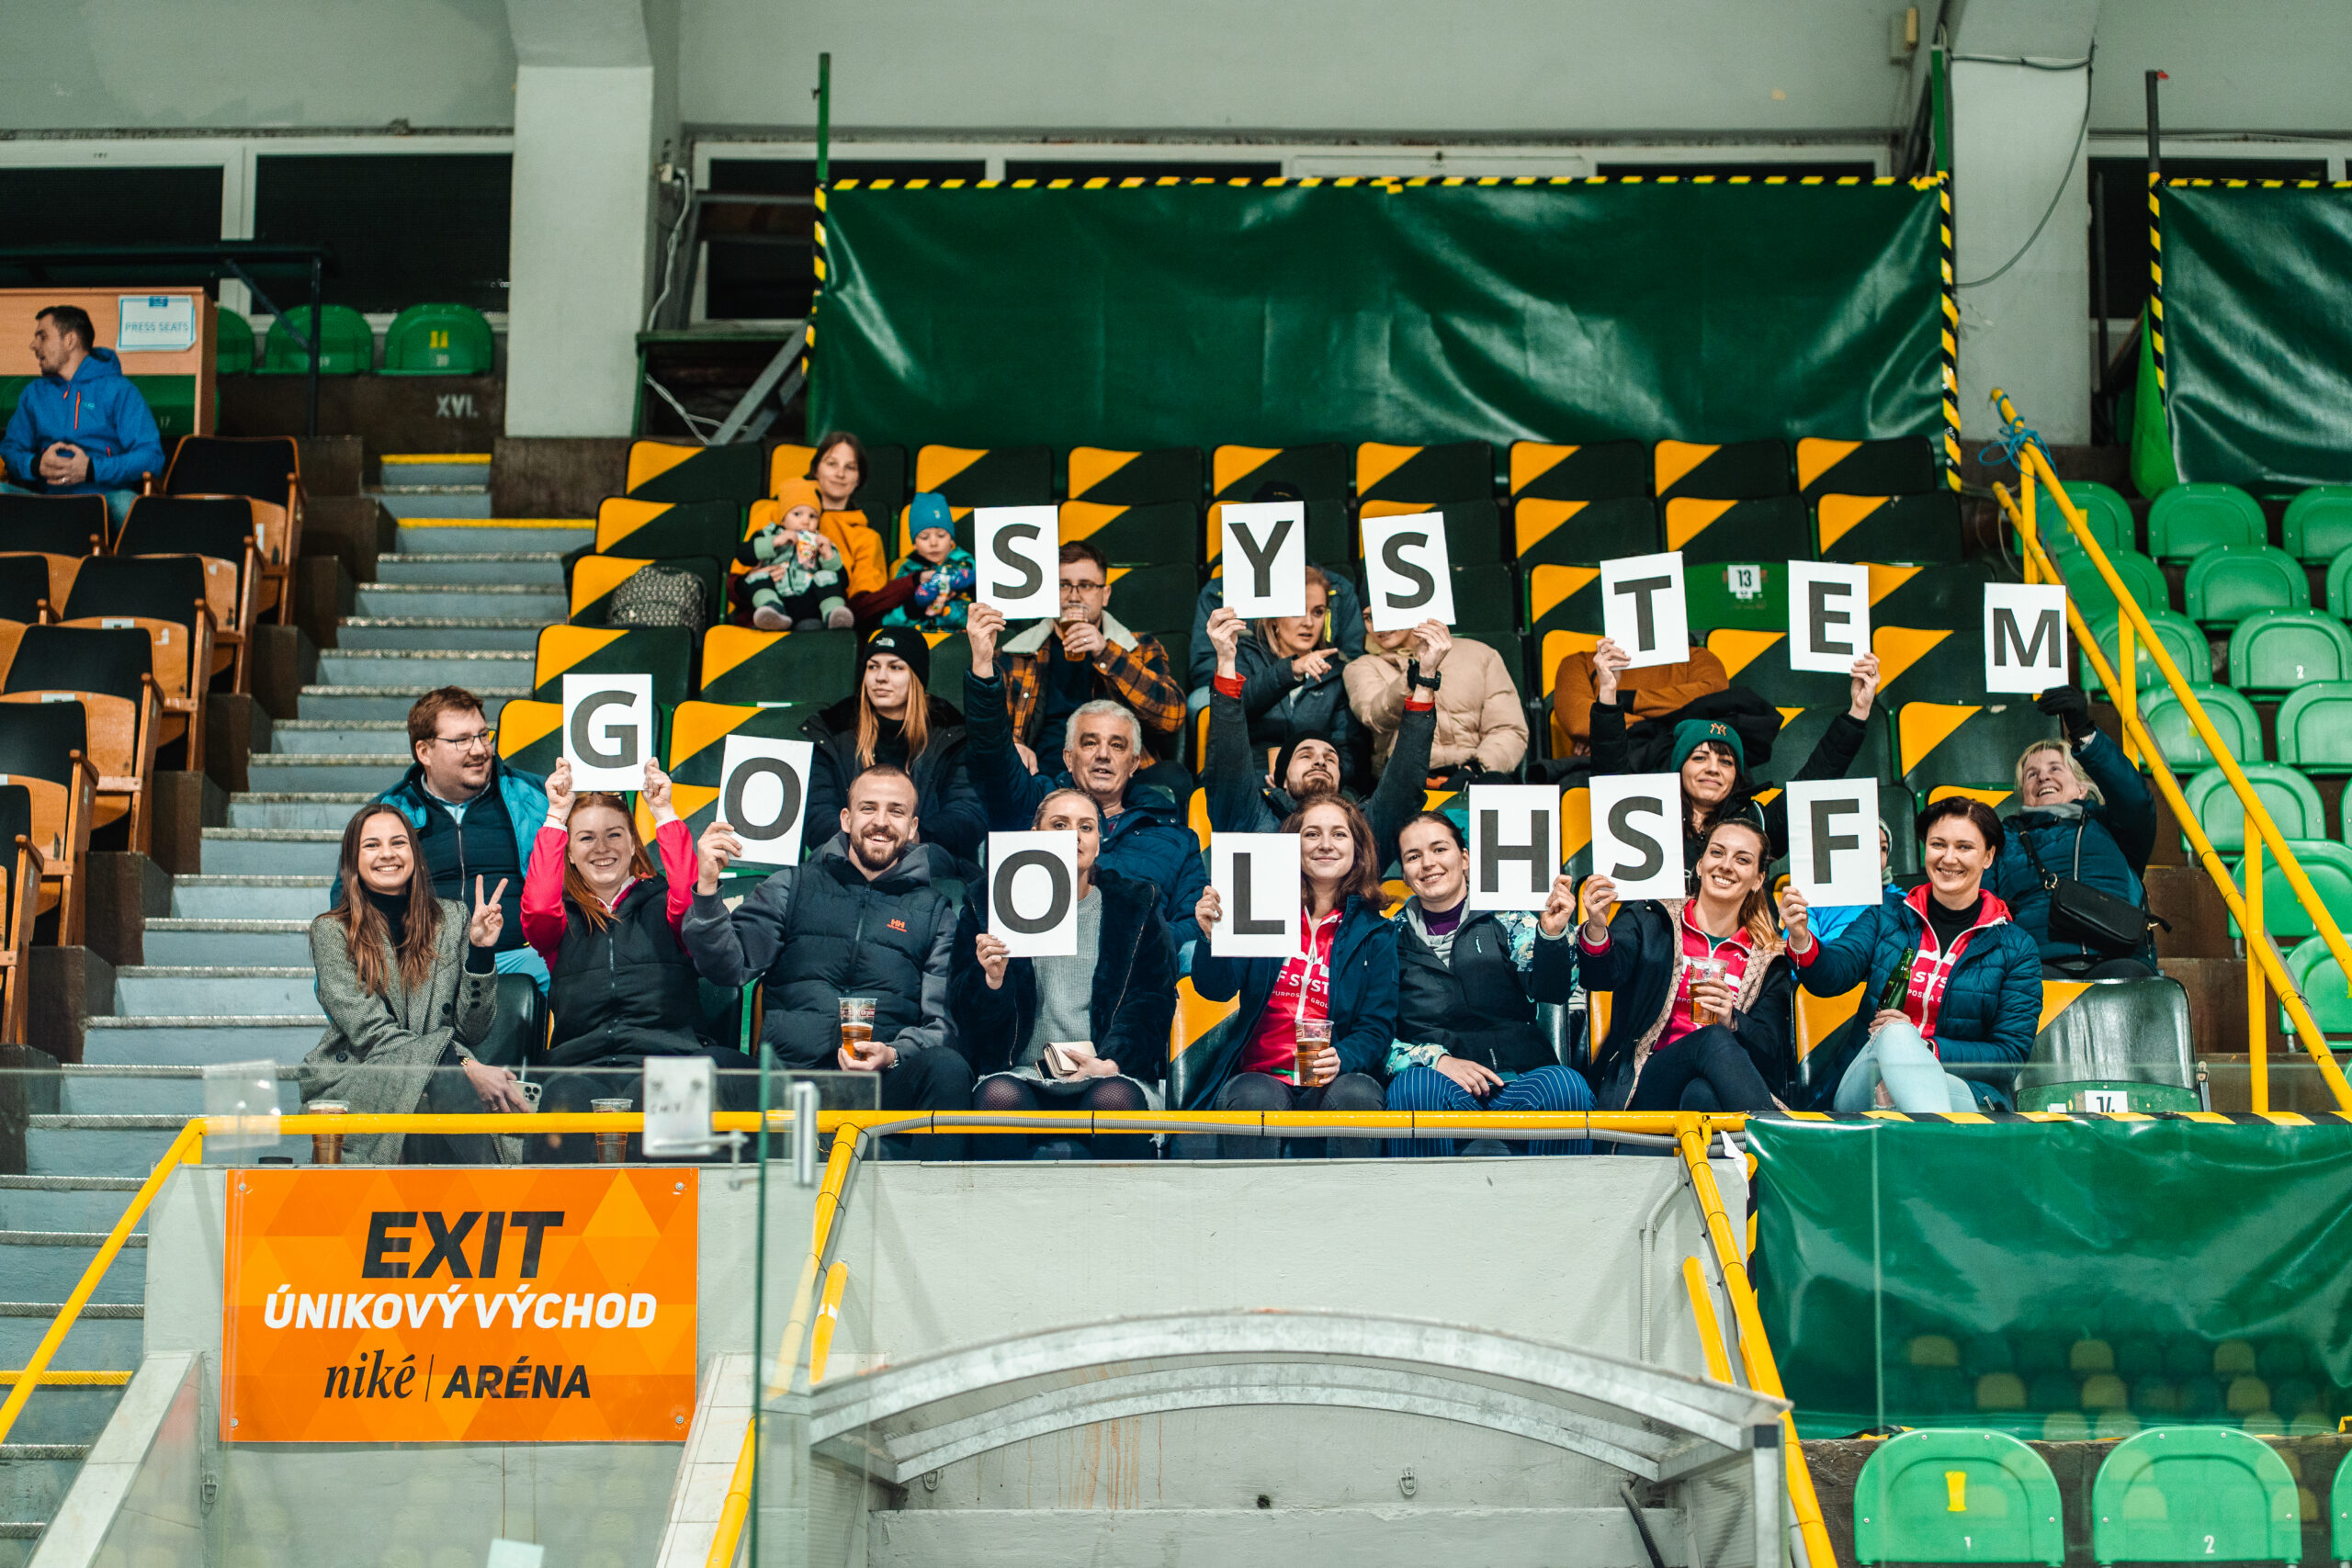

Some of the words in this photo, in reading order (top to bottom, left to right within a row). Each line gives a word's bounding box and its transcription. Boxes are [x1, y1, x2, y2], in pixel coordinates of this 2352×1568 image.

[125, 321, 155, 332] PRESS
[159, 321, 189, 332] SEATS
[435, 394, 480, 418] XVI.
[993, 524, 1042, 599] S
[1228, 520, 1295, 598] Y
[1382, 532, 1435, 609] S
[1736, 569, 1752, 588] 13
[1613, 575, 1672, 652] T
[1808, 581, 1854, 656] E
[1993, 607, 2062, 669] M
[2296, 664, 2305, 680] 2
[571, 690, 638, 769] G
[724, 757, 802, 841] O
[1479, 809, 1550, 893] H
[1607, 796, 1664, 882] S
[1810, 798, 1860, 885] F
[890, 919, 906, 929] HH
[993, 849, 1071, 934] O
[1232, 852, 1285, 935] L
[361, 1211, 565, 1279] EXIT
[264, 1283, 469, 1329] ÚNIKOVÝ
[474, 1283, 657, 1329] VÝCHOD
[323, 1348, 416, 1399] niké
[442, 1355, 591, 1399] ARÉNA
[1963, 1536, 1972, 1551] 1
[2203, 1535, 2215, 1554] 2
